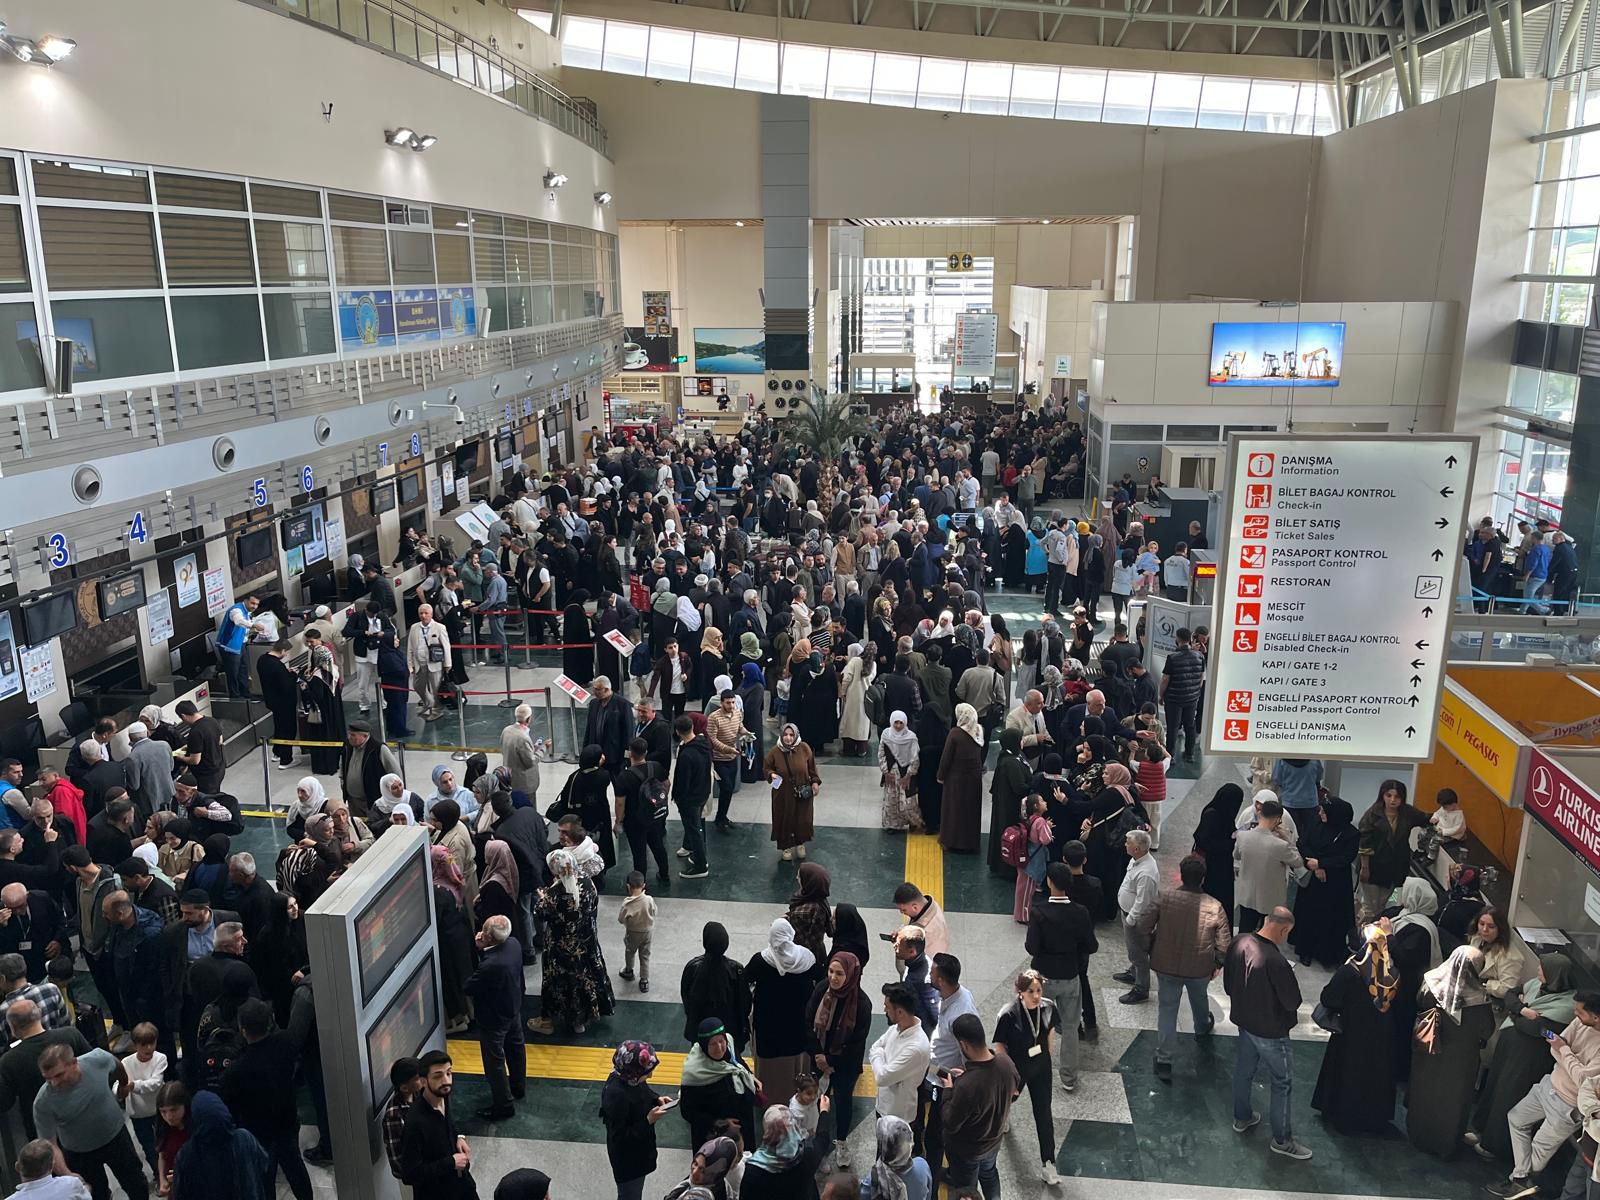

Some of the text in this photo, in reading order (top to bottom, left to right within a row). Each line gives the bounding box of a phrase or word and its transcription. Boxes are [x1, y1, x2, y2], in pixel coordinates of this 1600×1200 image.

[411, 433, 420, 456] 8
[379, 442, 388, 466] 7
[1281, 456, 1333, 467] DANIŞMA
[1280, 466, 1339, 476] Information
[304, 466, 313, 491] 6
[254, 478, 267, 506] 5
[1278, 486, 1396, 498] BİLET BAGAJ KONTROL
[1277, 501, 1322, 510] Check-in
[130, 512, 146, 543] 4
[1275, 518, 1341, 530] BİLET SATIŞ
[1275, 532, 1335, 541] Ticket Sales
[50, 533, 69, 567] 3
[1272, 548, 1388, 559] PASAPORT KONTROL
[1271, 559, 1356, 568] Passport Control
[1271, 577, 1331, 587] RESTORAN
[1267, 601, 1305, 611] MESCİT
[1267, 614, 1304, 623] Mosque
[1264, 632, 1401, 645] ENGELLİ BİLET BAGAJ KONTROL
[1264, 644, 1349, 654] Disabled Check-in
[1262, 661, 1286, 669] KAPI
[1293, 662, 1320, 670] GATE
[1323, 662, 1338, 671] 1-2
[1260, 677, 1284, 685] KAPI
[1291, 678, 1318, 686] GATE
[1258, 693, 1410, 705] ENGELLİ PASAPORT KONTROL
[1257, 704, 1380, 715] Disabled Passport Control
[1256, 721, 1346, 732] ENGELLİ DANIŞMA
[1255, 731, 1352, 742] Disabled Information
[1464, 730, 1499, 767] PEGASUS
[1554, 804, 1600, 857] AIRLINE
